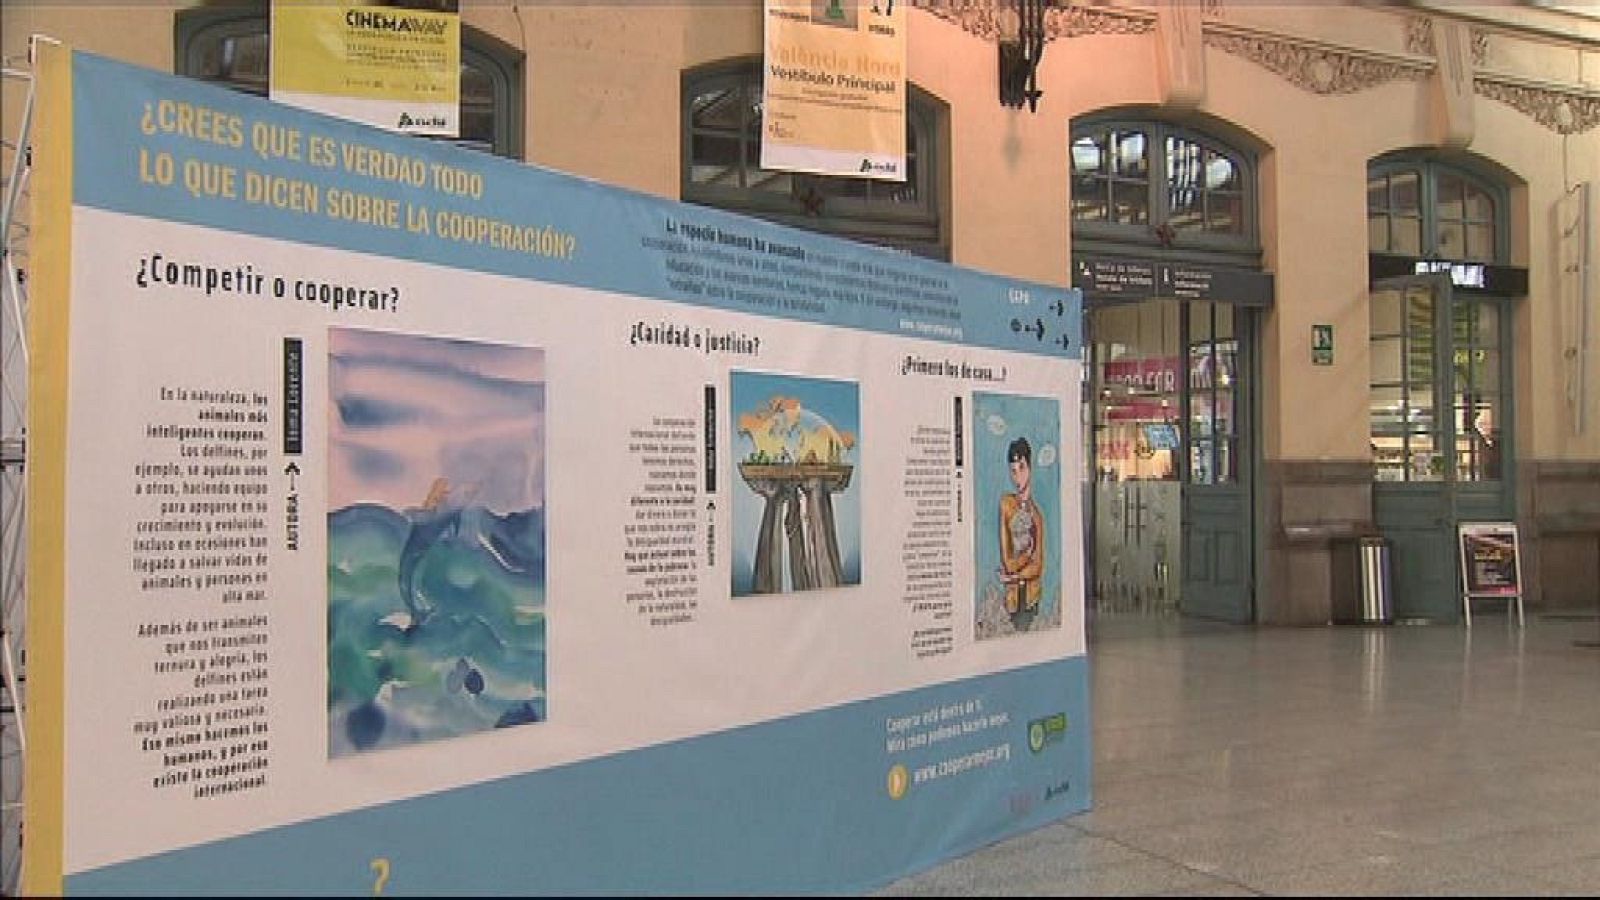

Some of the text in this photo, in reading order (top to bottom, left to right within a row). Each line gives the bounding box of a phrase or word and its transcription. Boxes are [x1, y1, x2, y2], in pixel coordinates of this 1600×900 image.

[346, 9, 447, 35] CINEMAWAY
[141, 99, 483, 201] ¿CREES QUE ES VERDAD TODO
[140, 149, 576, 260] LO QUE DICEN SOBRE LA COOPERACIÓN?
[136, 254, 400, 313] ¿Competir o cooperar?
[630, 321, 760, 356] ¿Caridad o justicia?
[161, 387, 174, 401] En
[178, 387, 187, 401] la
[286, 494, 298, 550] AUTORA
